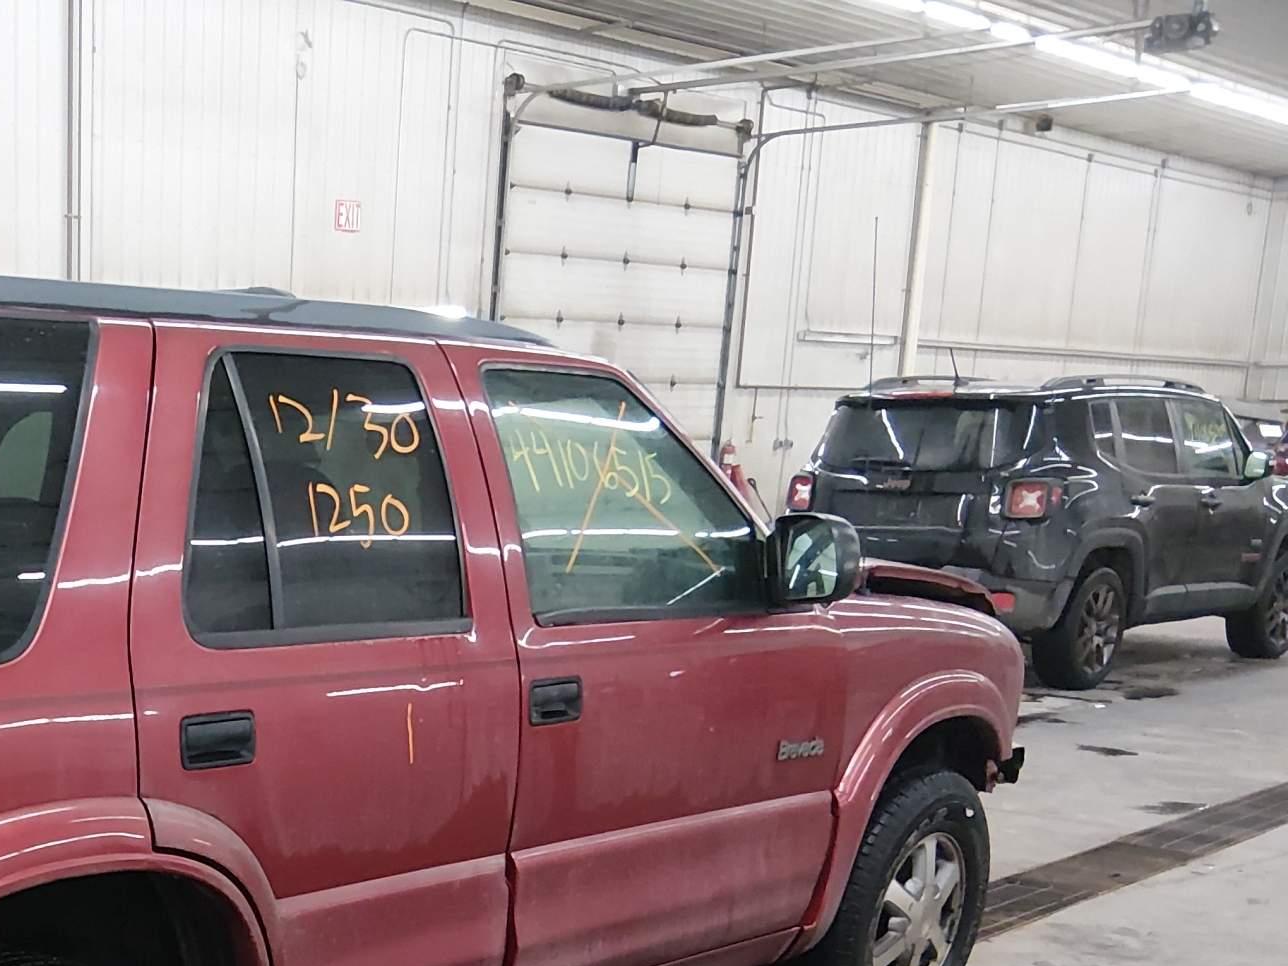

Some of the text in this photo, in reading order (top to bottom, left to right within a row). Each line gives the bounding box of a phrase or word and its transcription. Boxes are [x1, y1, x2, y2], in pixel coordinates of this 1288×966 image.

[337, 202, 361, 229] EXIT
[512, 428, 673, 505] 44106515
[307, 480, 411, 550] 1250
